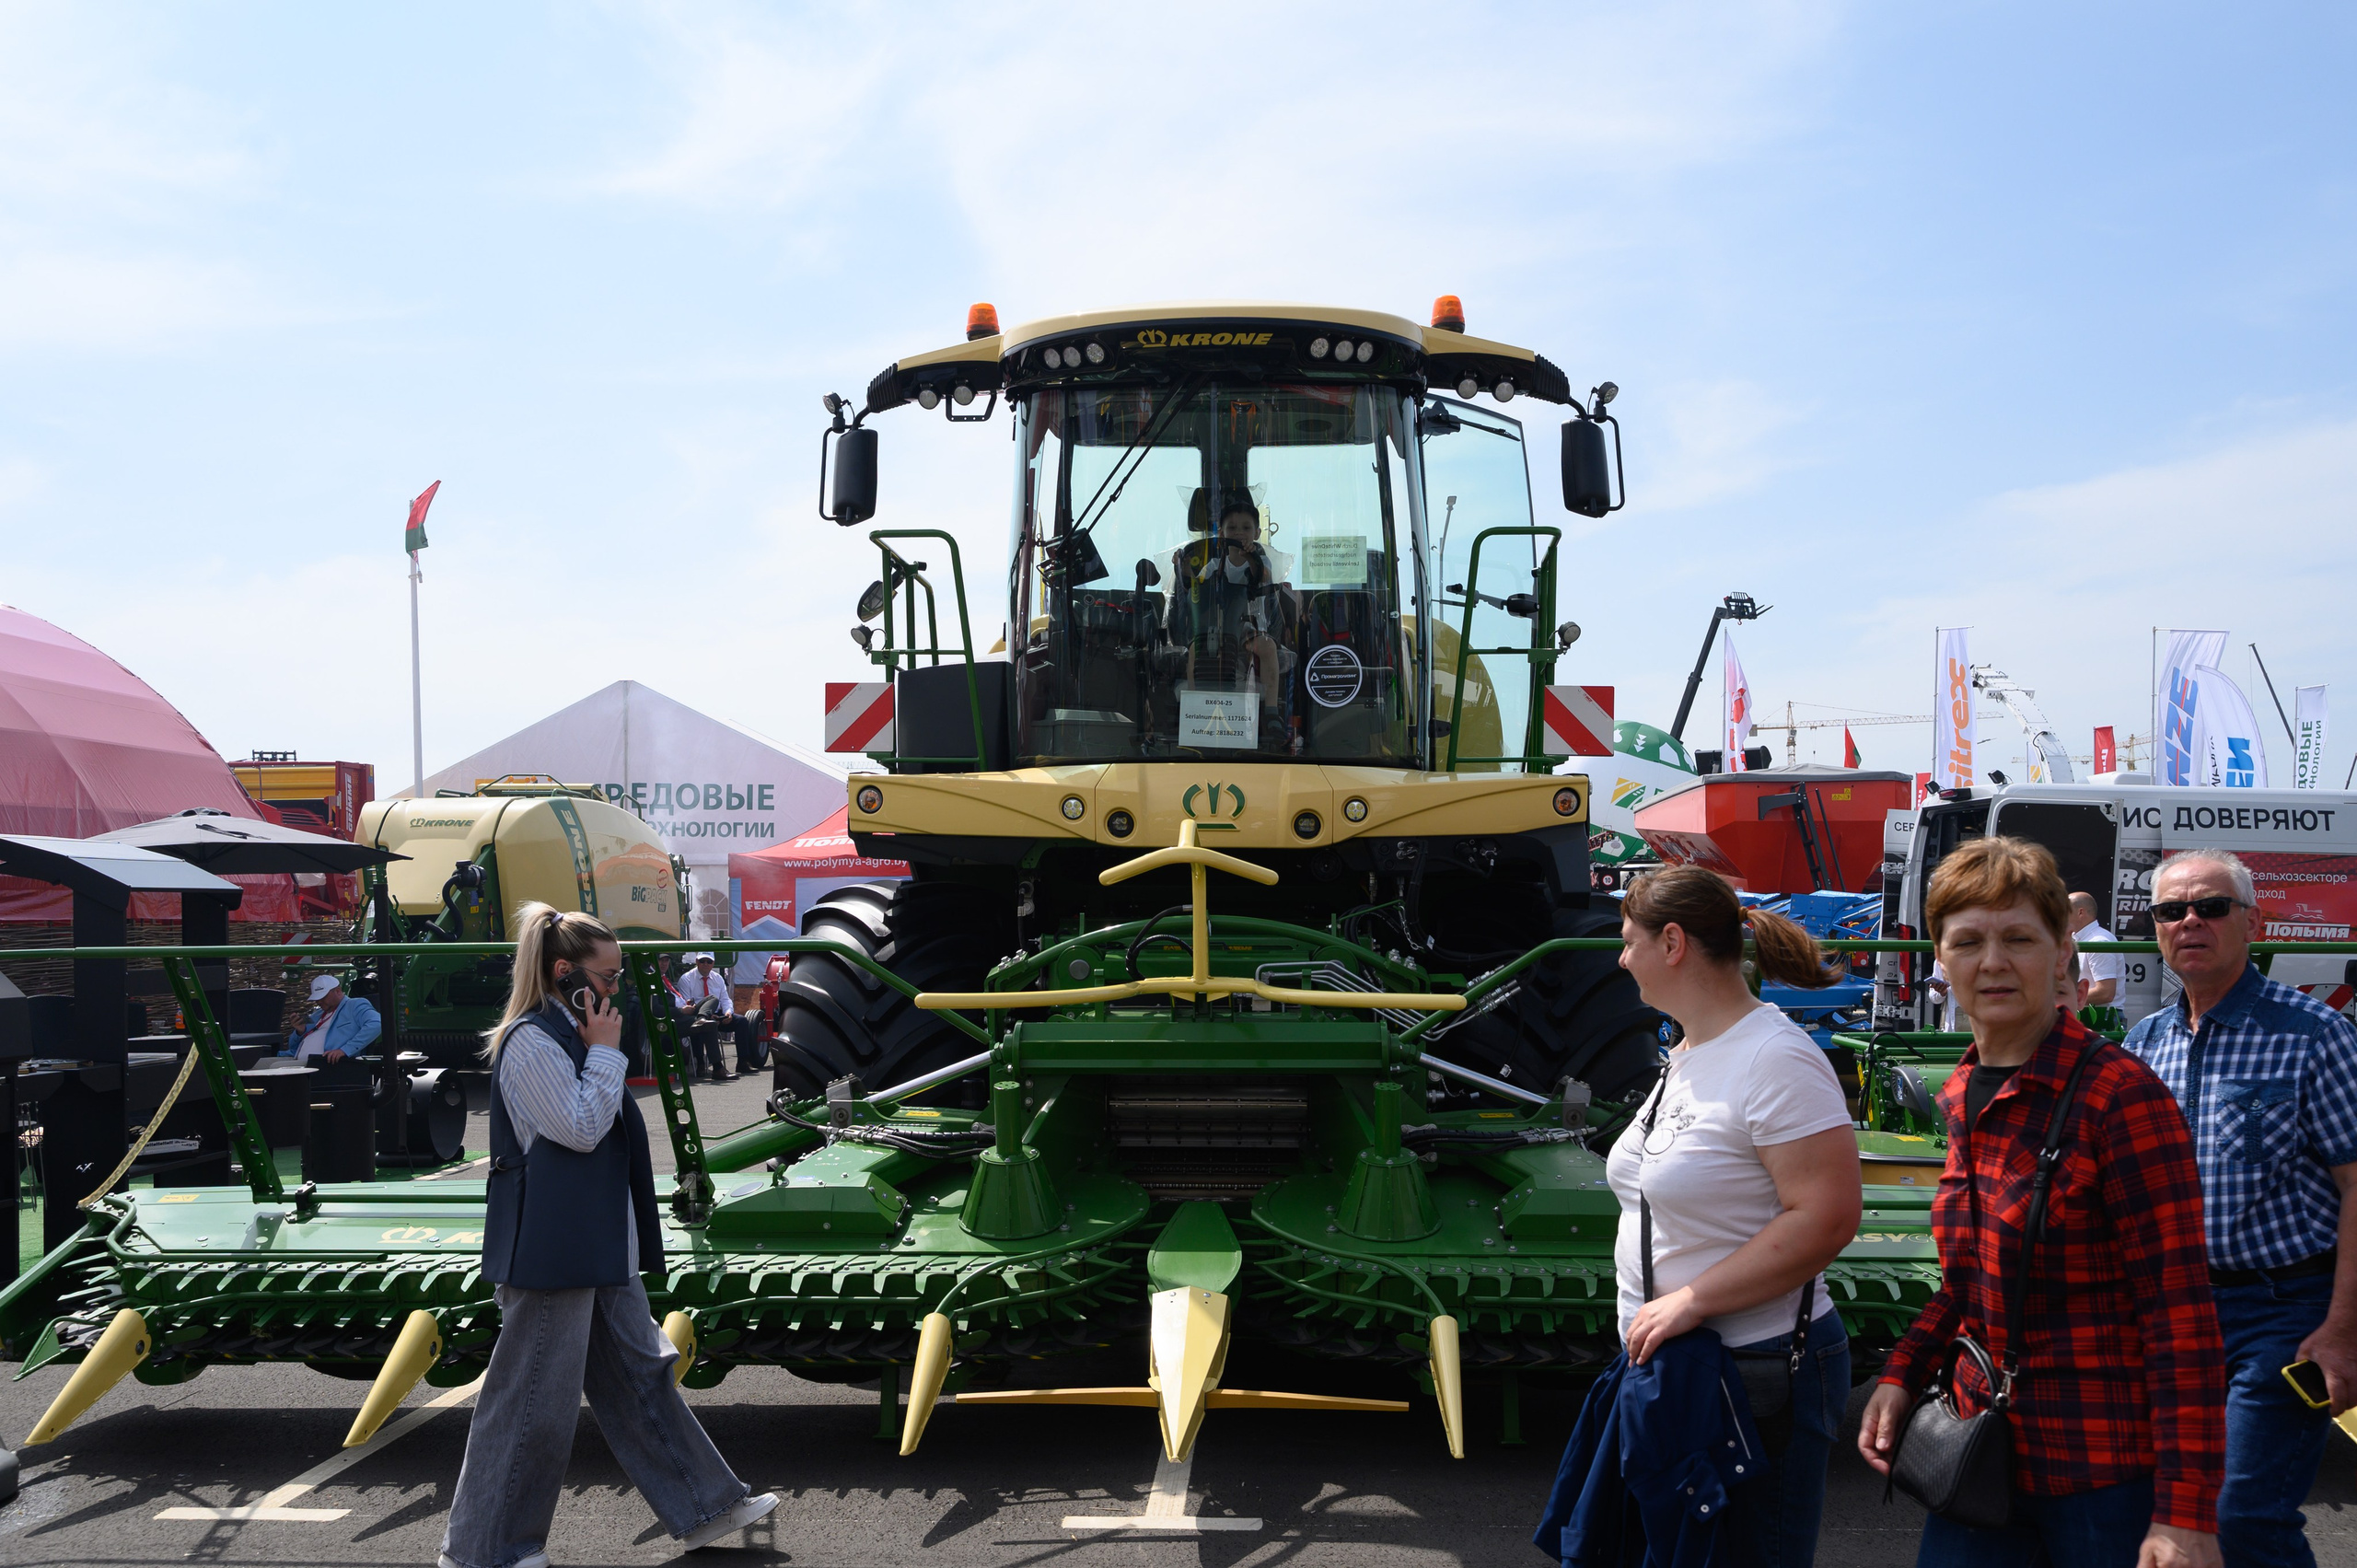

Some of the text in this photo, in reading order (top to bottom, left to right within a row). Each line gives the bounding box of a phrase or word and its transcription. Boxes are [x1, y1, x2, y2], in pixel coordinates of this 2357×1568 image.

[1169, 332, 1273, 347] KRONE
[1191, 728, 1215, 737] Auftrag:
[2165, 667, 2199, 786] NZE
[344, 772, 353, 832] GRIMME
[595, 783, 775, 816] РЕДОВЫЕ
[424, 819, 475, 828] KRONE
[2173, 807, 2336, 831] ДОВЕРЯЮТ
[561, 809, 594, 912] KRONE
[784, 857, 908, 869] www.polymya-agro.by
[2251, 872, 2348, 885] сельхозсекторе
[745, 900, 792, 911] FENDT
